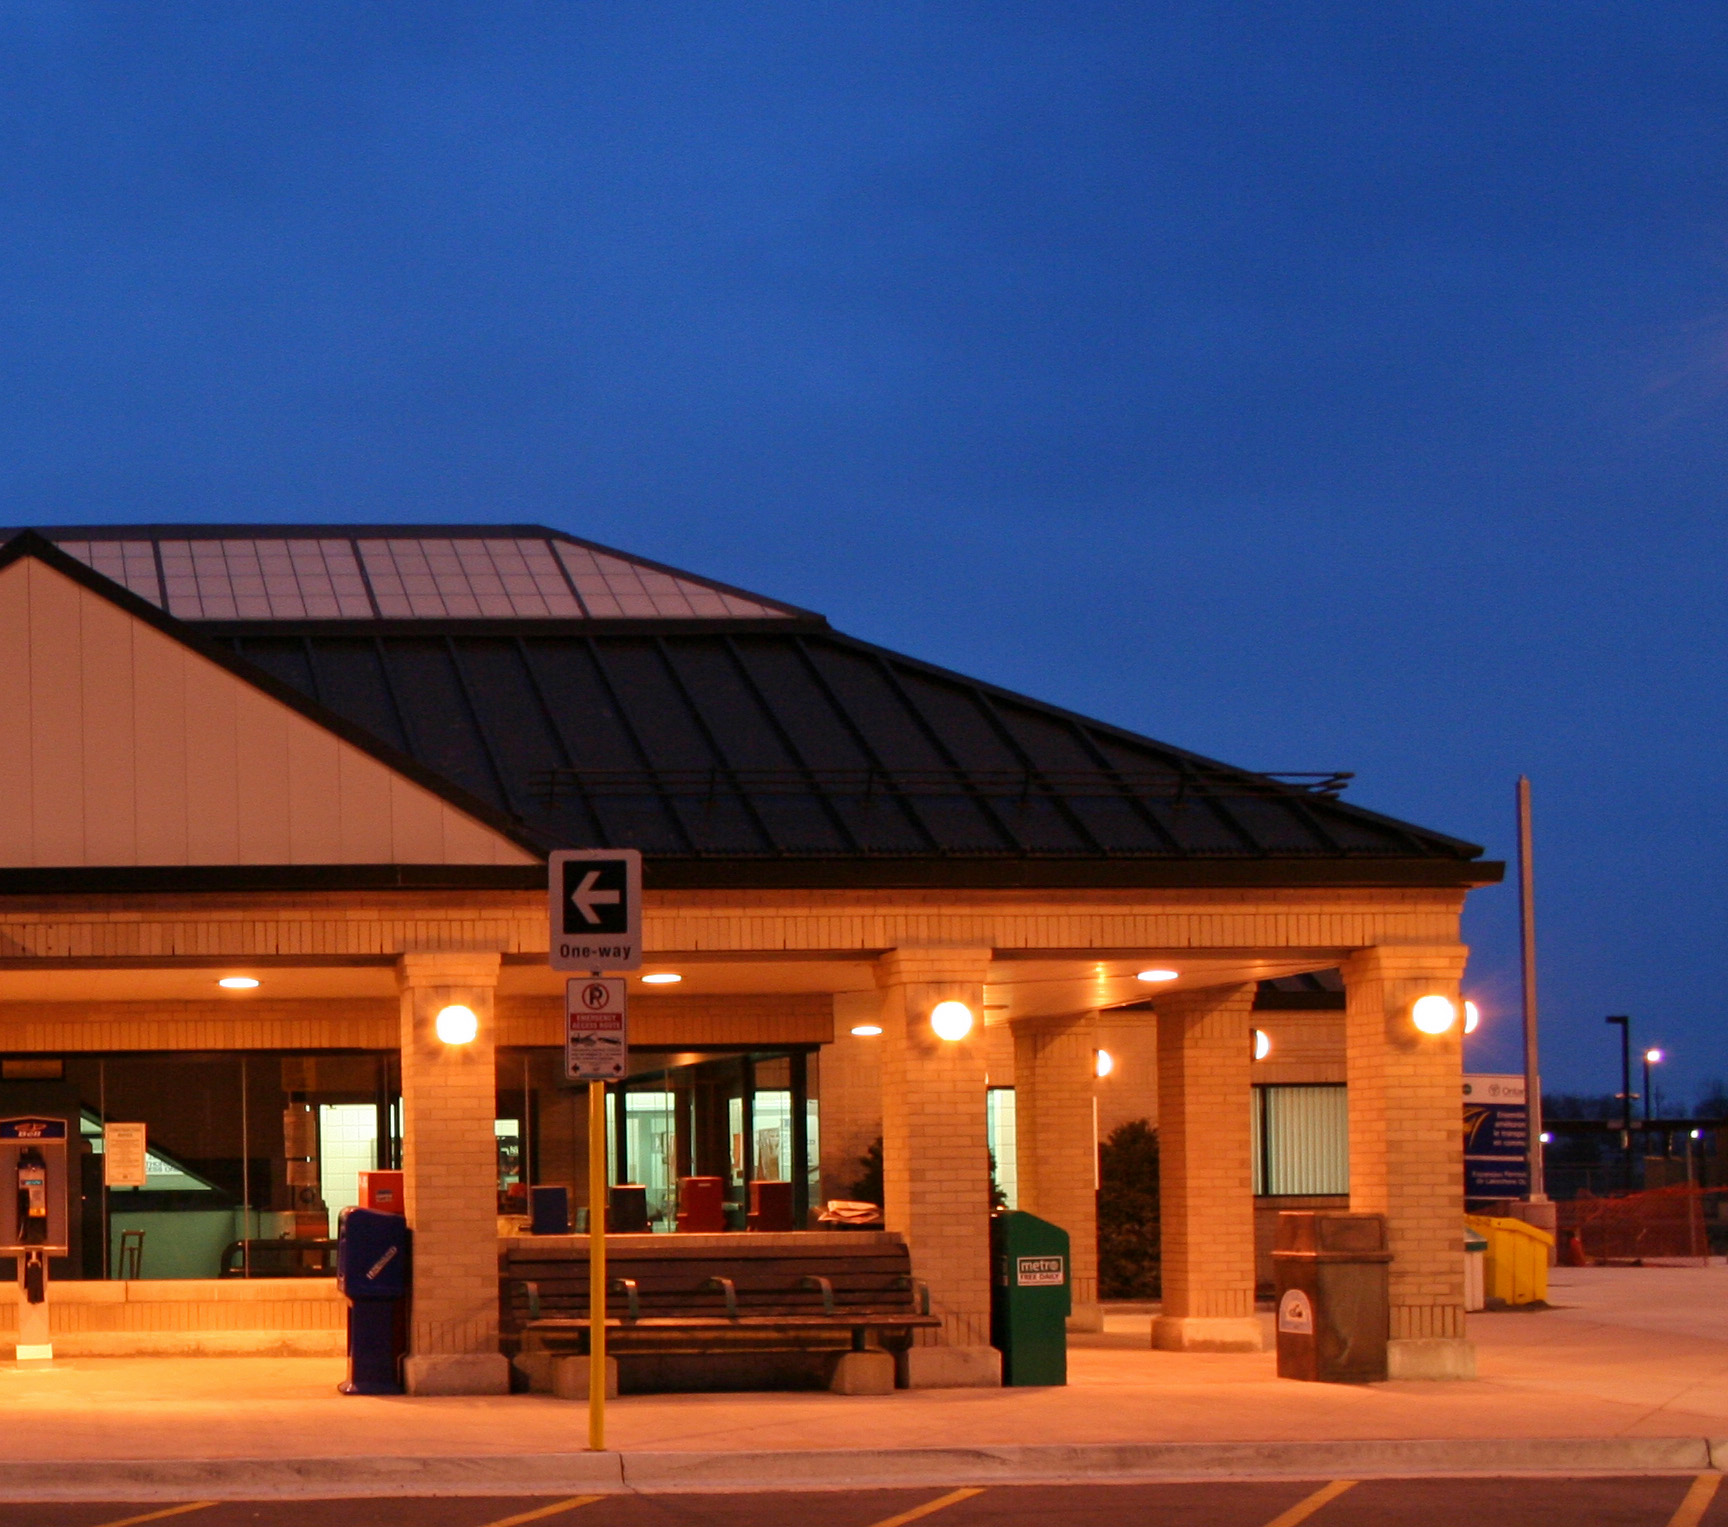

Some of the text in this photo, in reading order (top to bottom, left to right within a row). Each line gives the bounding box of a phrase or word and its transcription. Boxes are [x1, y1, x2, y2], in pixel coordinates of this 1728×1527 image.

[560, 944, 632, 961] One-way
[576, 1014, 617, 1022] EMERGENCY
[571, 1022, 621, 1030] ACCESS ROUTE
[17, 1130, 42, 1138] Bell
[1021, 1260, 1059, 1271] metro
